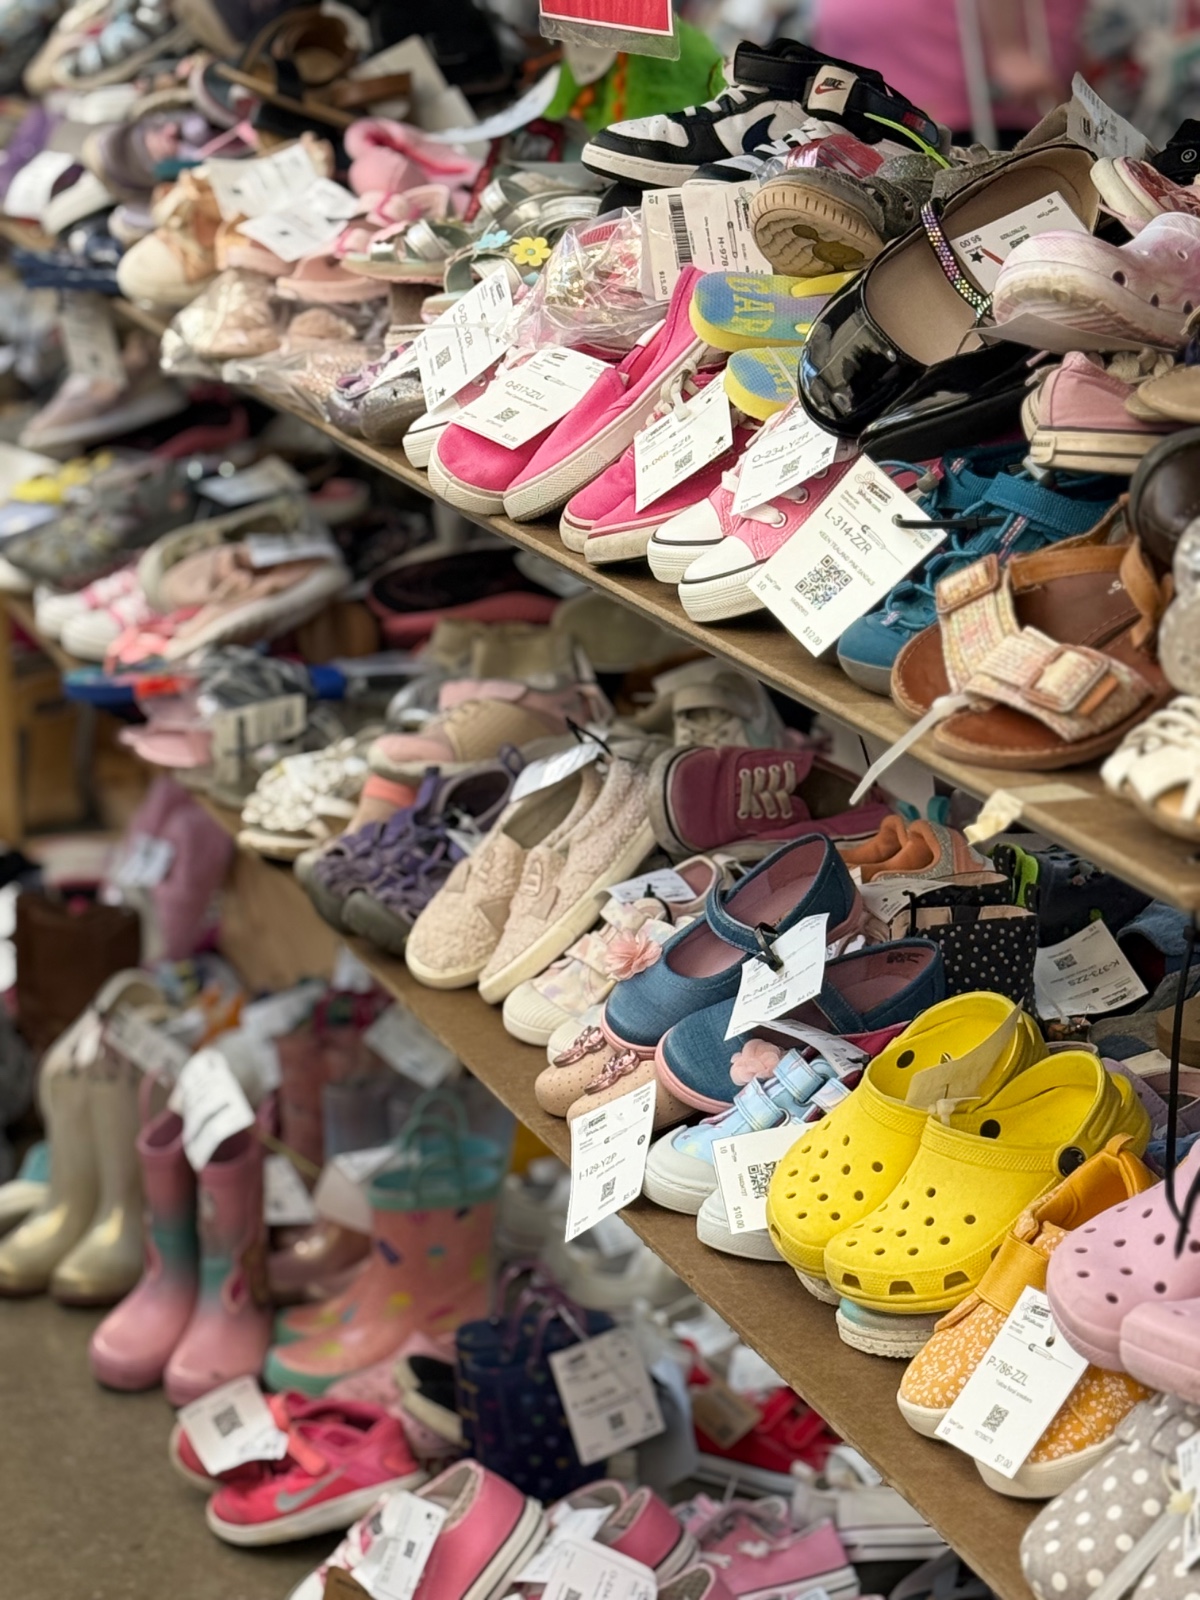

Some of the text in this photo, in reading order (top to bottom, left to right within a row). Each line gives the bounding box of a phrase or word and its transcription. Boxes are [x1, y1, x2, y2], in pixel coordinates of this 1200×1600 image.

[822, 77, 845, 88] NIKE
[647, 194, 654, 204] 10
[658, 270, 667, 295] $15.00
[726, 276, 775, 333] GAP
[823, 505, 874, 556] L-314-ZZR
[756, 580, 767, 591] 10
[801, 625, 823, 647] $12.00
[1067, 959, 1120, 987] K-373-ZZS
[719, 1145, 727, 1155] 10
[733, 1205, 745, 1229] $10.00
[986, 1355, 1030, 1387] P-786-ZZL
[994, 1453, 1013, 1470] $7.00
